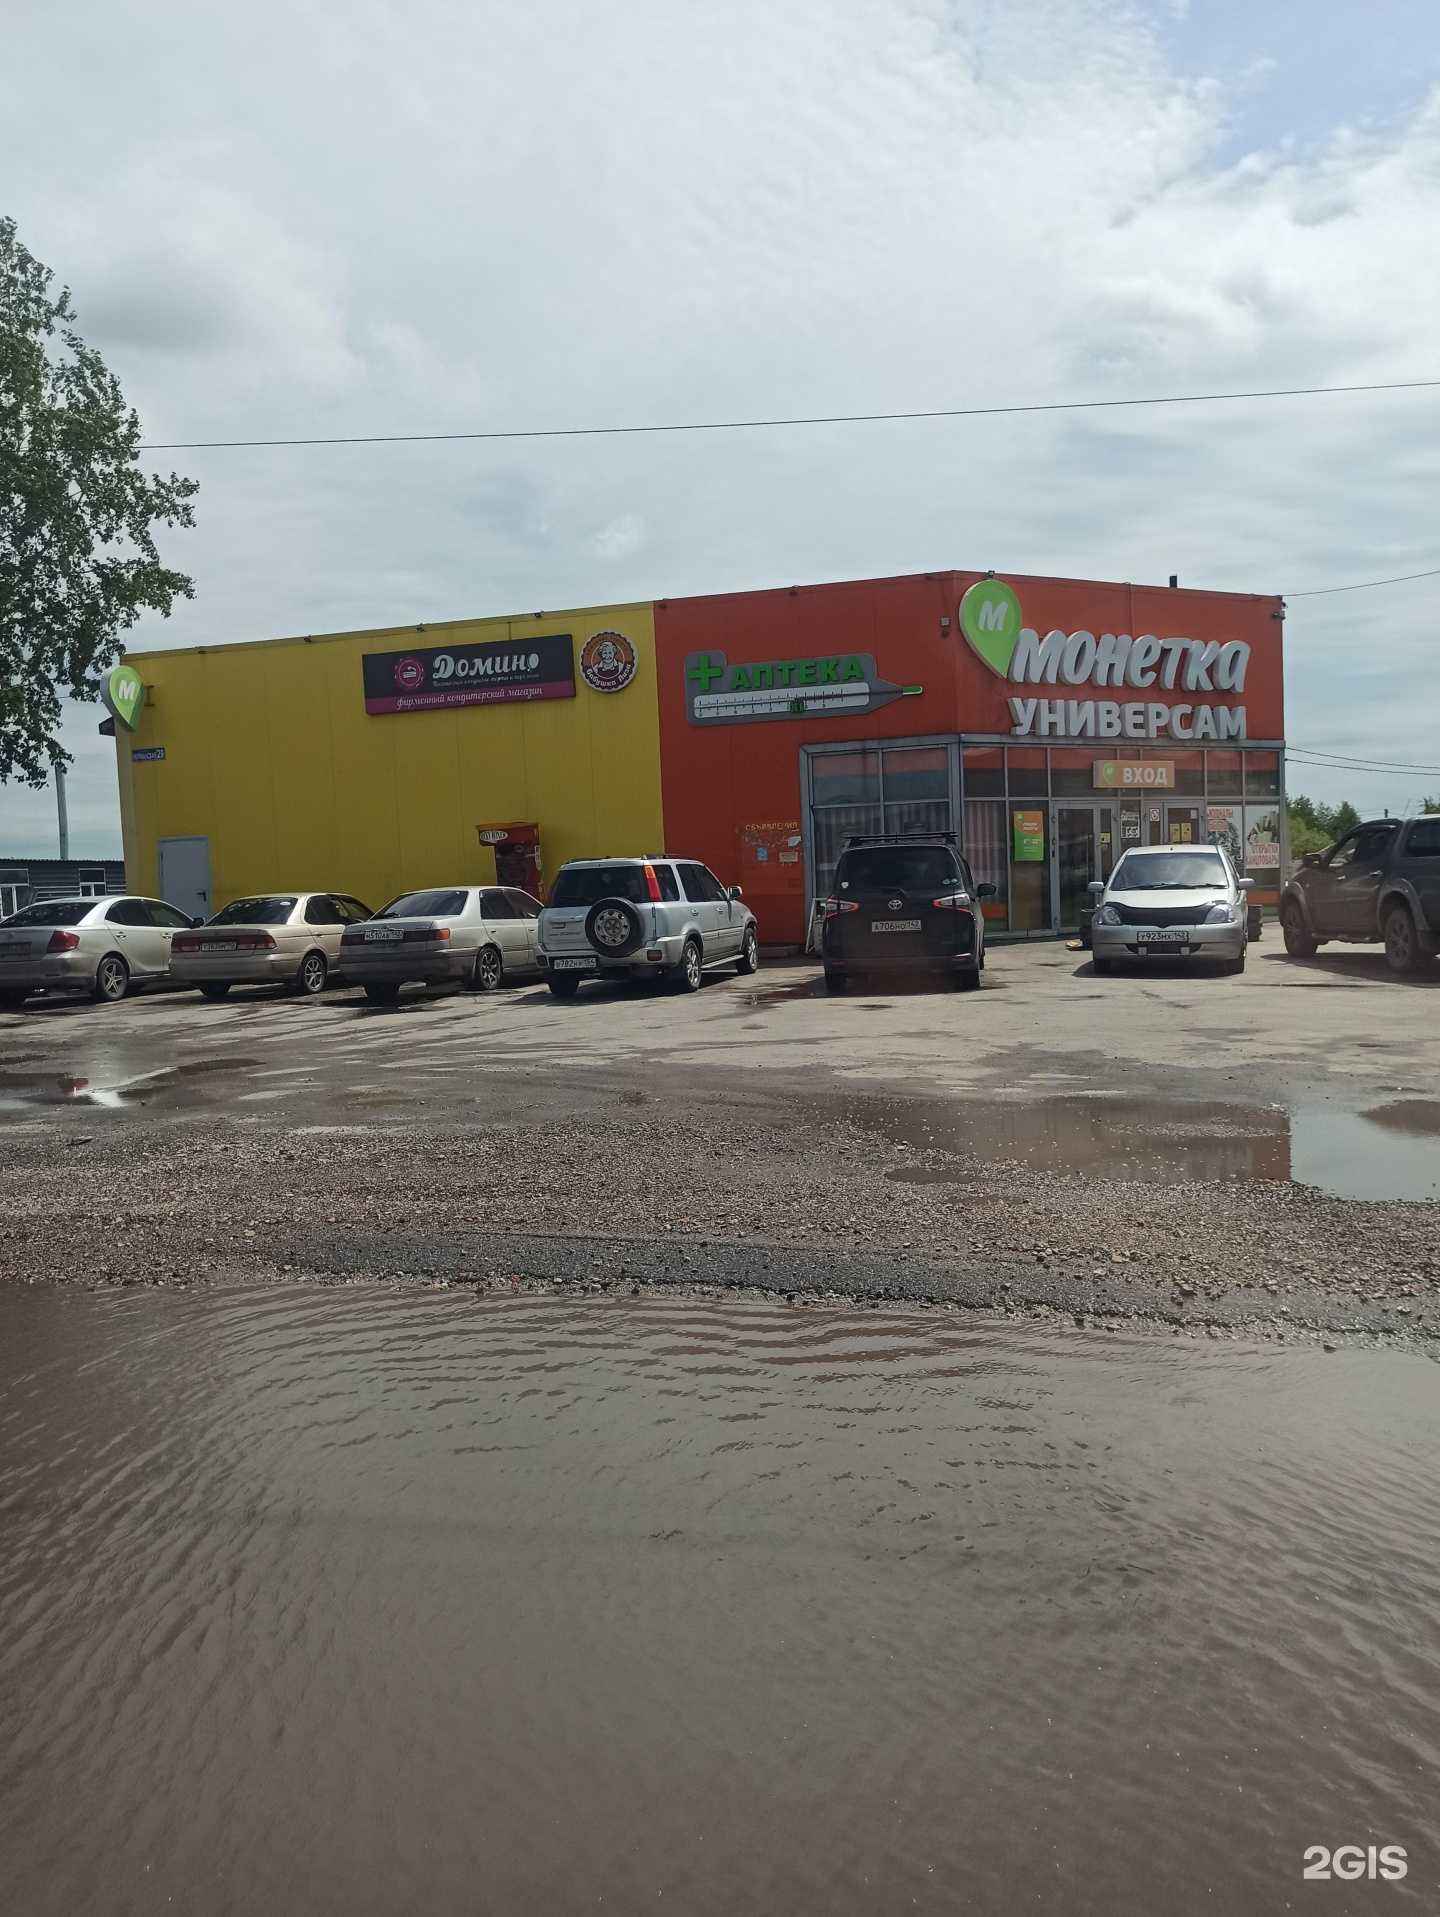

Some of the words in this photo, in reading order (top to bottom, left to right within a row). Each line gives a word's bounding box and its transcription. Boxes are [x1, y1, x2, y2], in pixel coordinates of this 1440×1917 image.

[433, 653, 540, 680] Домино
[733, 656, 864, 689] АПТЕКА
[446, 689, 505, 705] кондитерский
[507, 687, 543, 699] магазин
[1008, 697, 1247, 739] УНИВЕРСАМ
[1122, 767, 1168, 785] ВХОД
